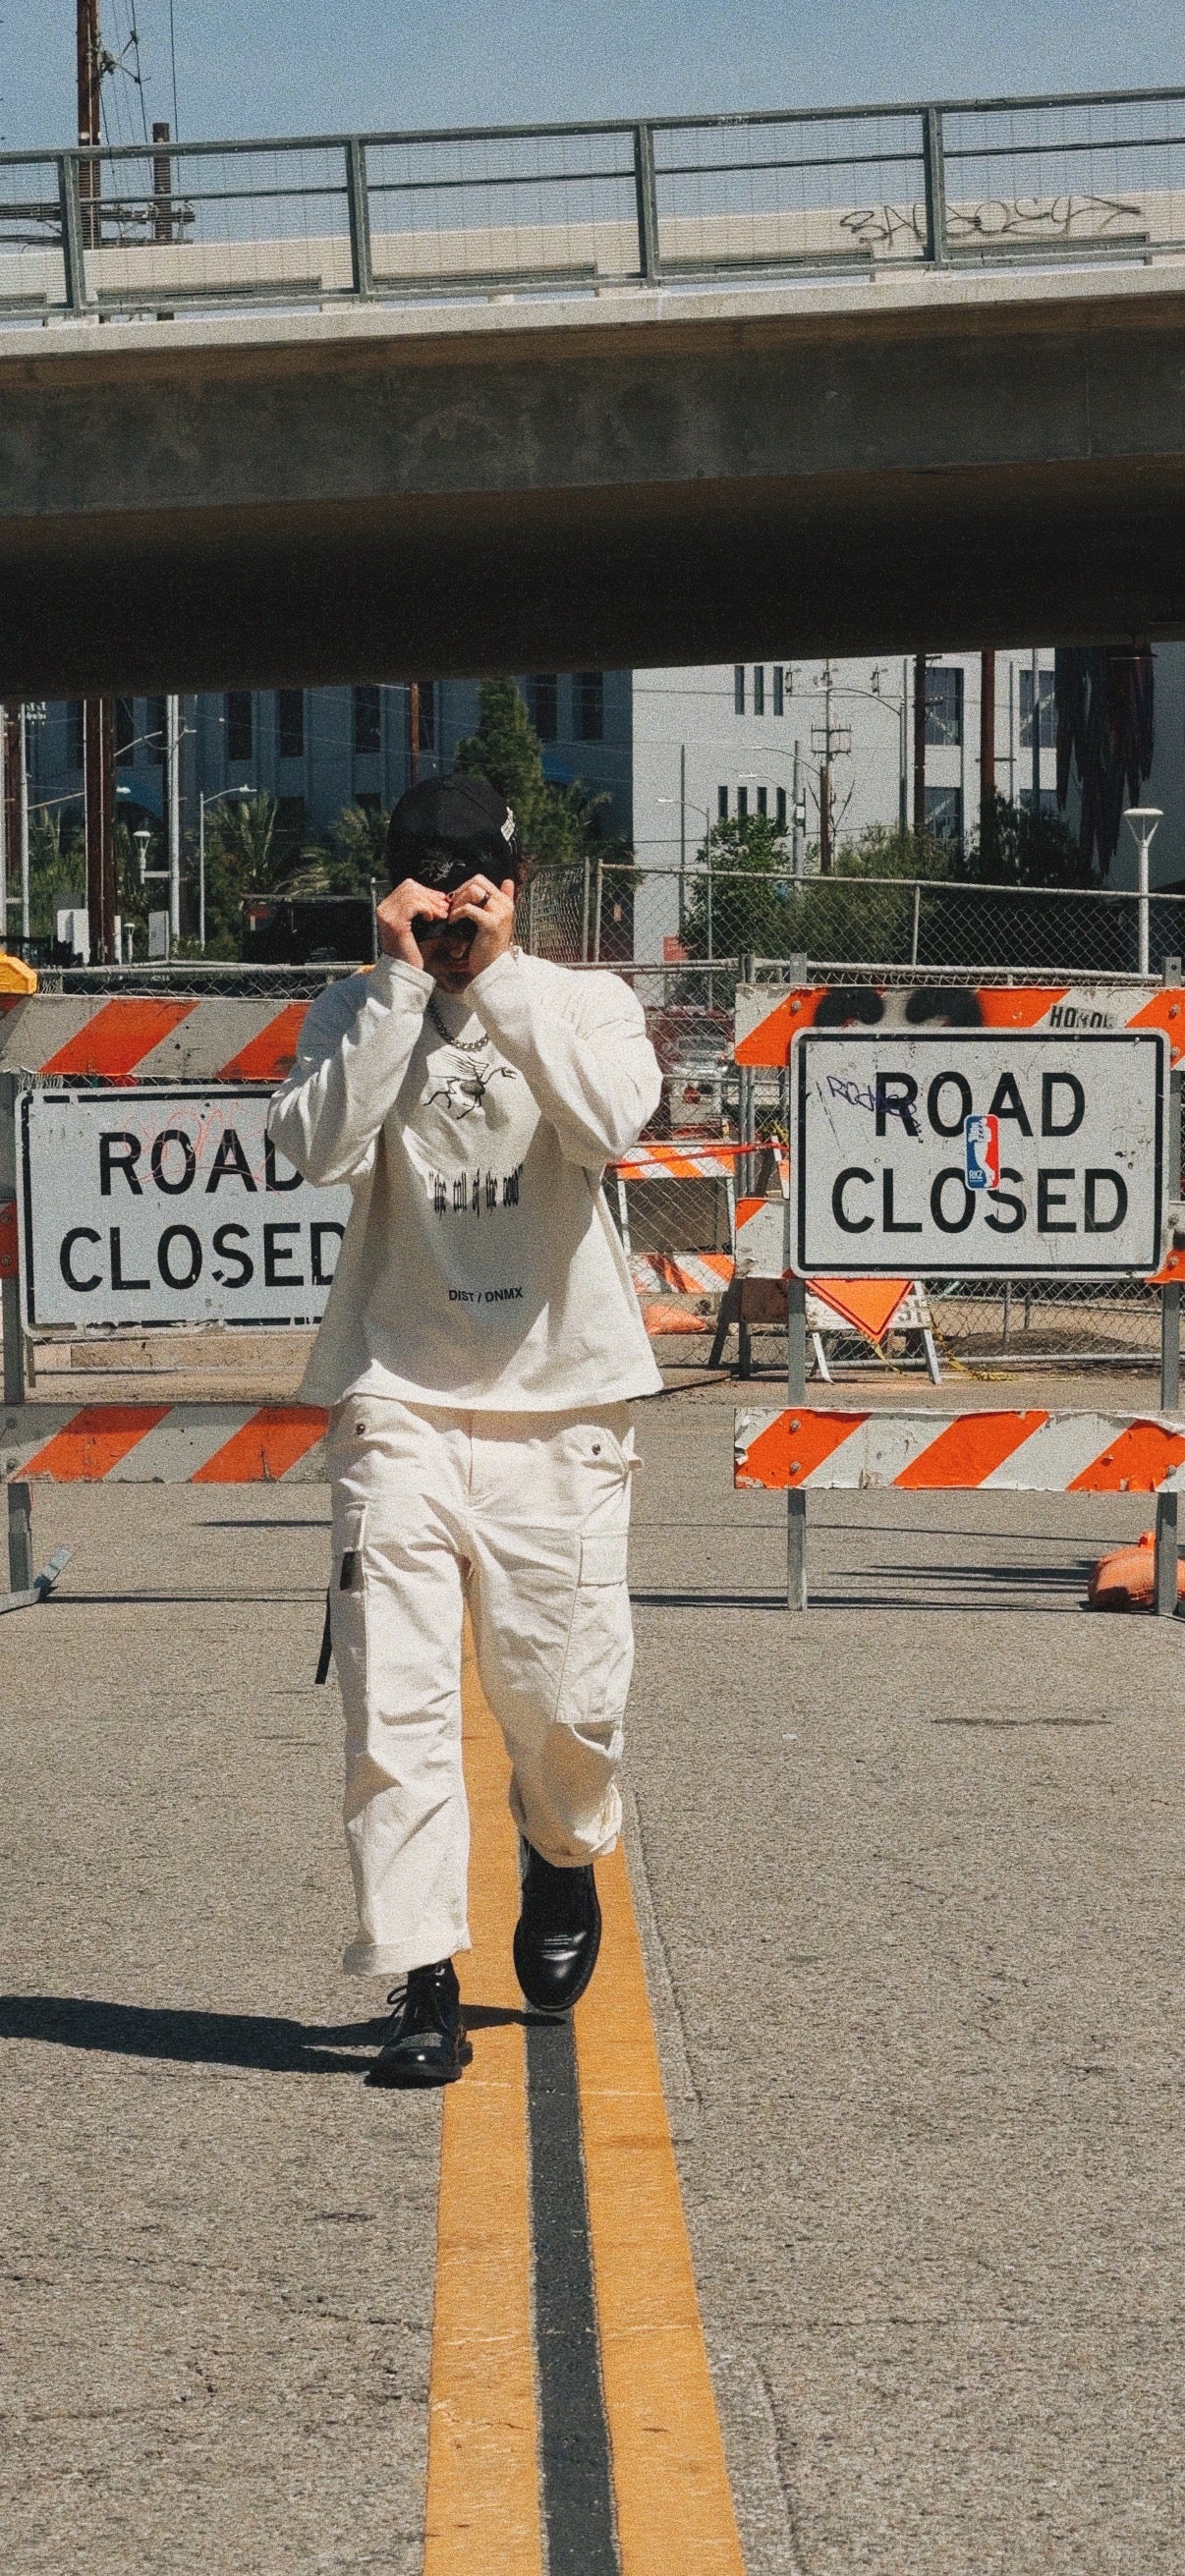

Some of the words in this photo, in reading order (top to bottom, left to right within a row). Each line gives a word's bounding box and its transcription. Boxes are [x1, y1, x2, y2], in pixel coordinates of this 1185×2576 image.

[875, 1072, 1086, 1137] ROAD
[832, 1167, 1128, 1234] CLOSED
[60, 1222, 346, 1292] CLOSED
[448, 1289, 474, 1303] DIST
[484, 1286, 524, 1303] DNMX
